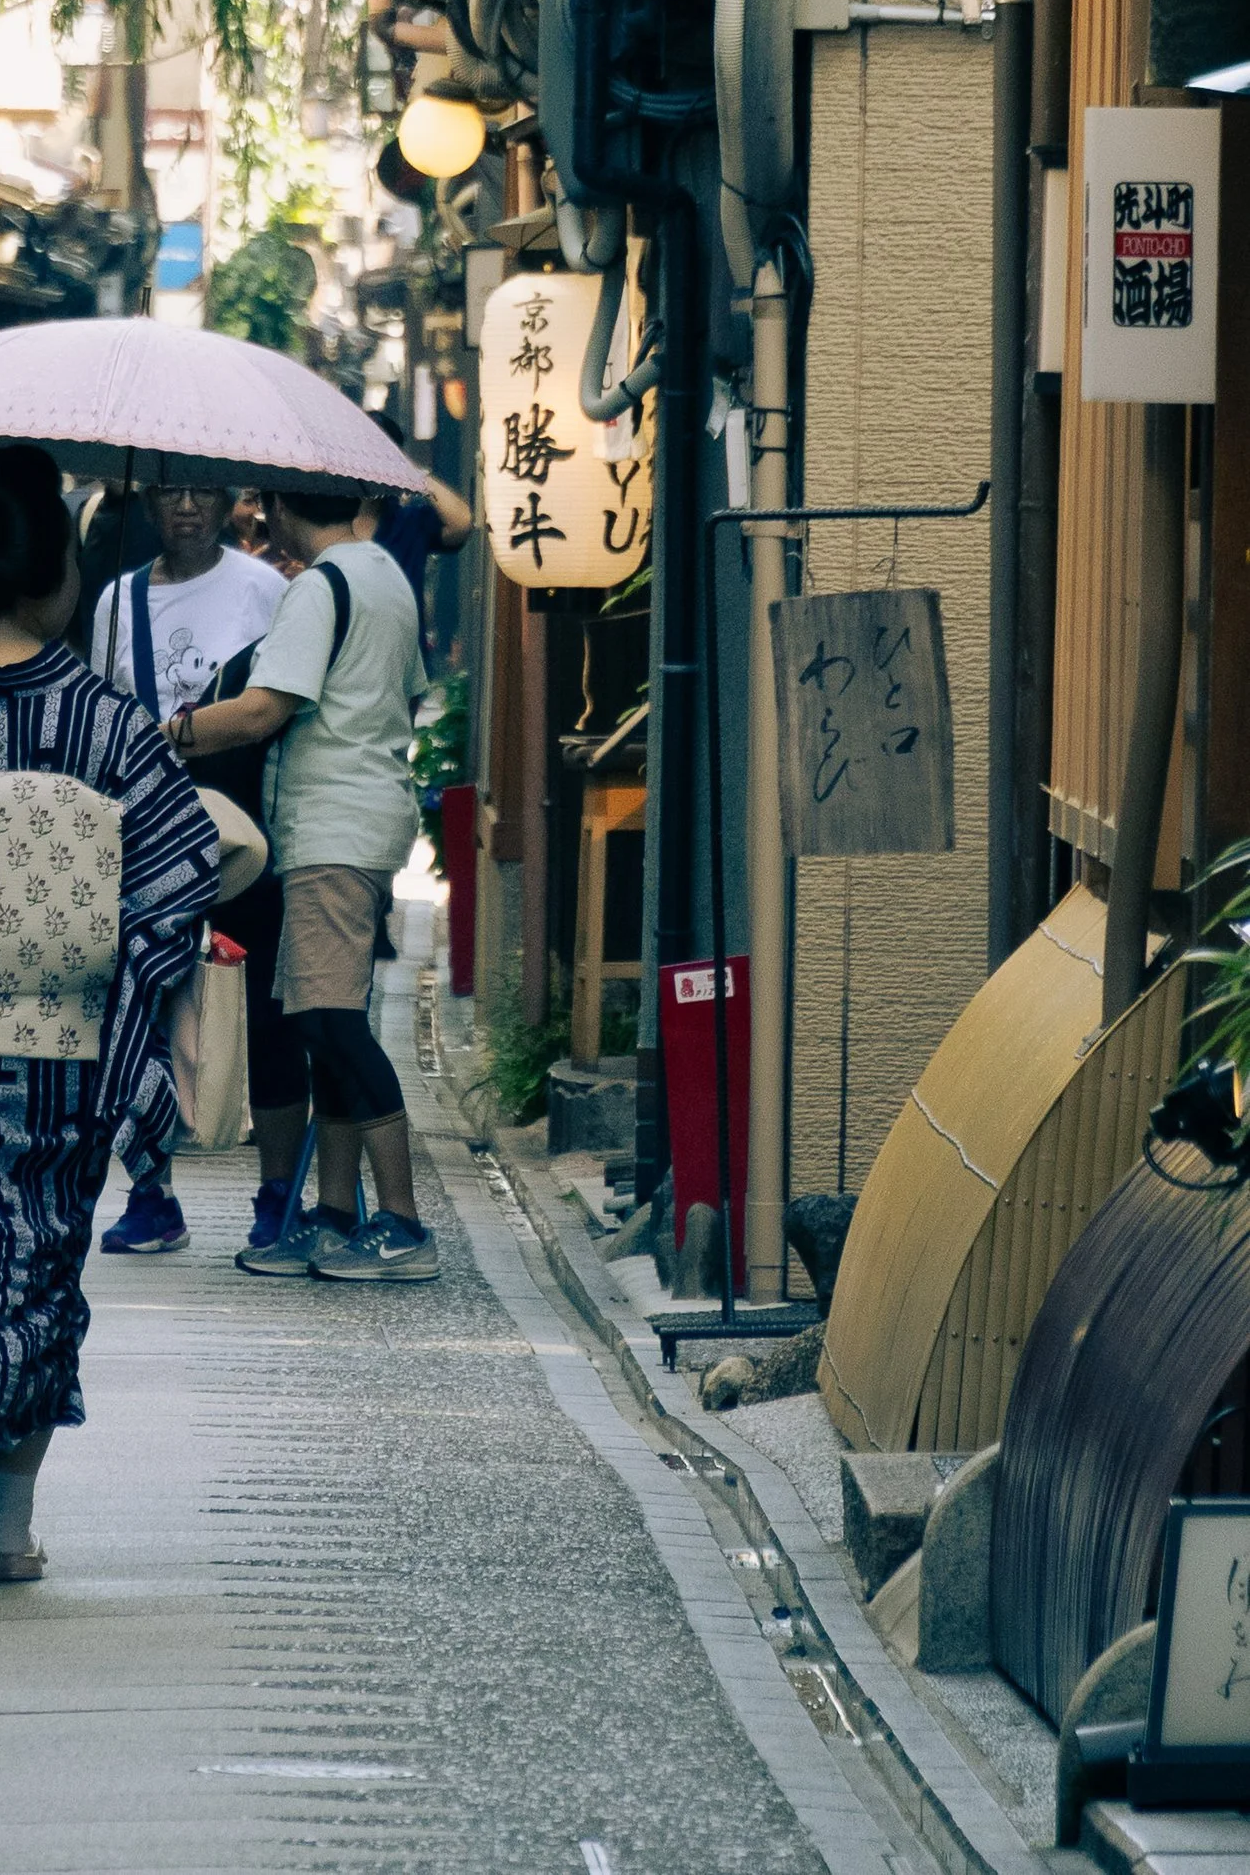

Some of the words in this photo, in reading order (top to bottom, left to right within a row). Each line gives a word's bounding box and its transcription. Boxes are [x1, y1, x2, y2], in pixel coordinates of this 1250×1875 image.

[1115, 183, 1192, 230] 先斗町
[1122, 236, 1187, 256] PONTO-CHO
[1114, 259, 1192, 326] 酒場
[500, 291, 577, 571] 京都勝牛
